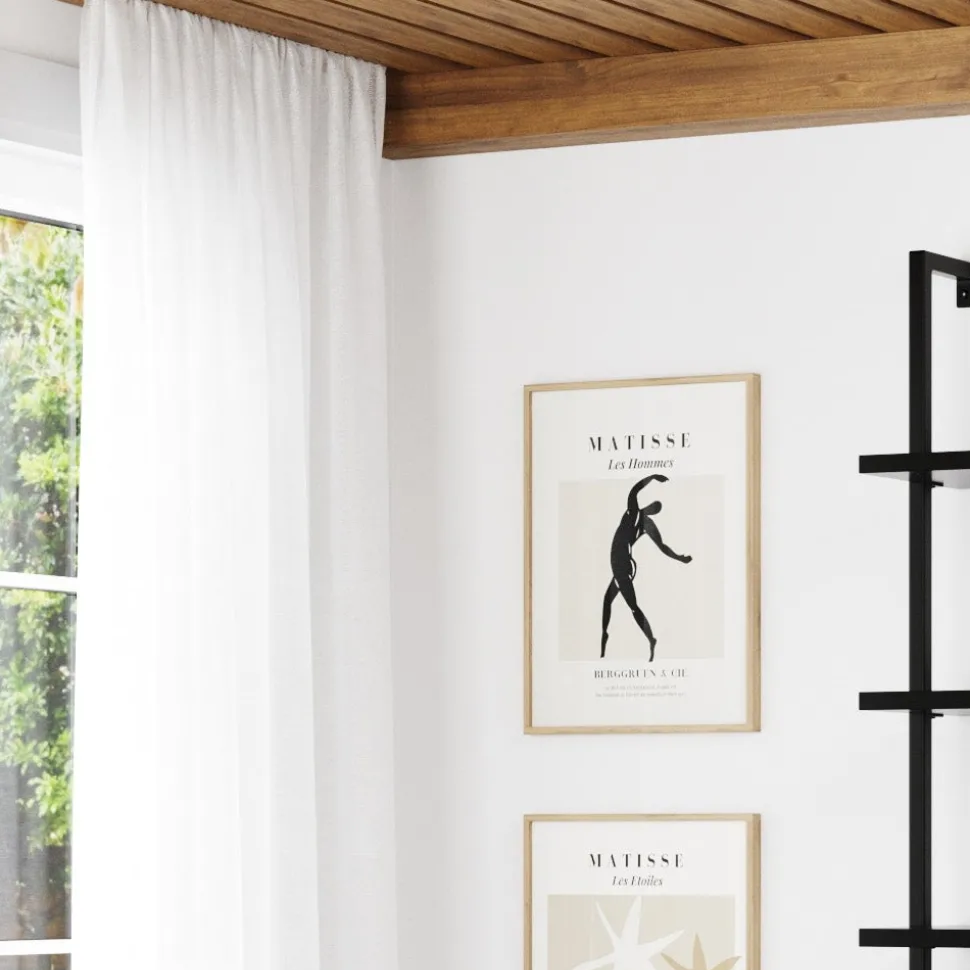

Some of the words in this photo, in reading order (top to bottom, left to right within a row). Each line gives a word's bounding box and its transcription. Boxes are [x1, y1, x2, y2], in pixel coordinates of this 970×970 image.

[588, 432, 690, 452] MATISSE
[608, 459, 625, 470] Les
[628, 458, 674, 469] Hommes
[588, 853, 684, 868] MATISSE
[612, 875, 628, 886] Les
